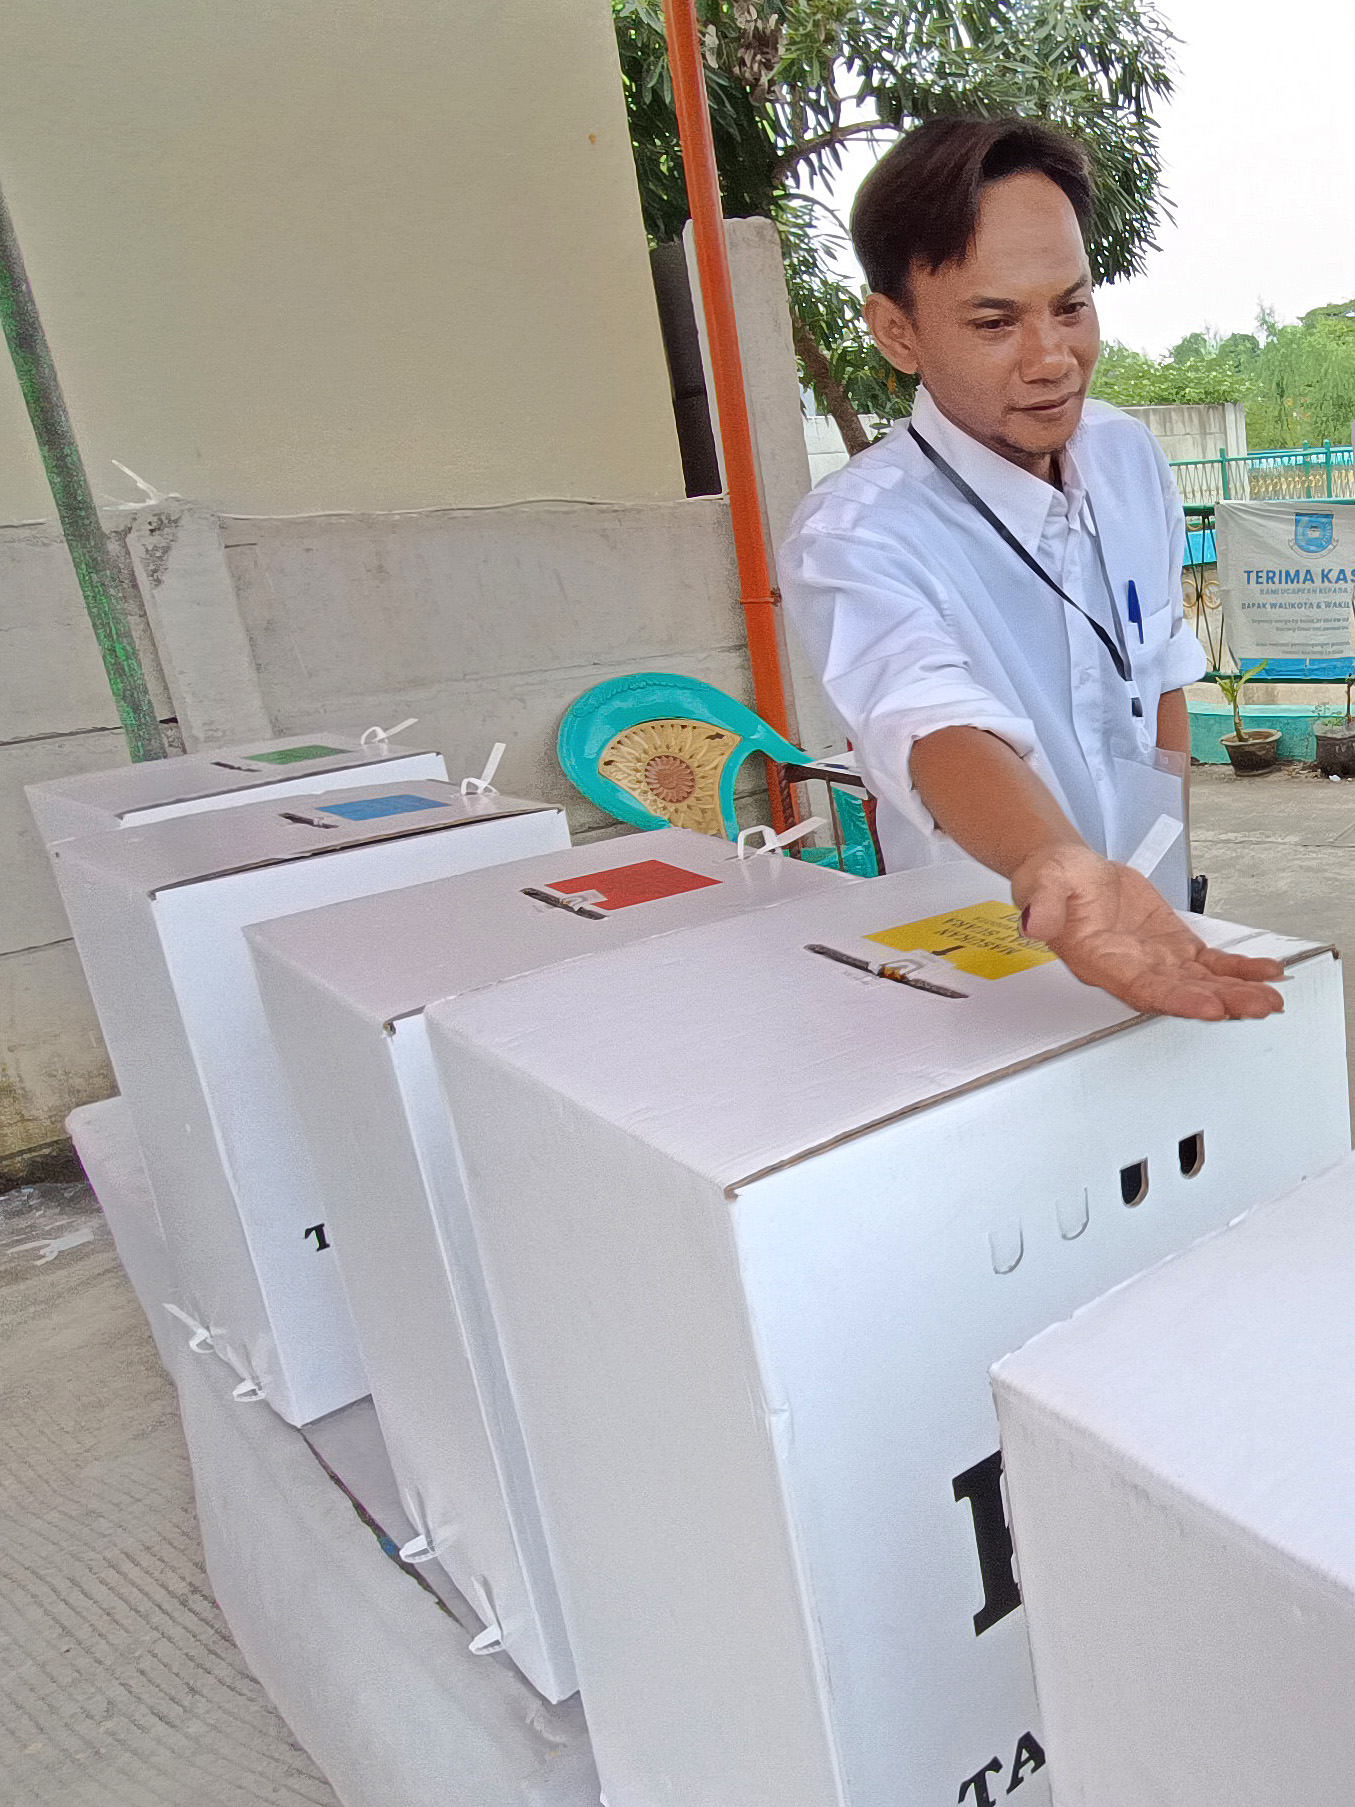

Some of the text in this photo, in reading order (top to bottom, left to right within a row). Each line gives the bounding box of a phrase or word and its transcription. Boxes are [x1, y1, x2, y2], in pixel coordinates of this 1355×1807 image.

[1243, 569, 1315, 585] TERIMA
[1241, 602, 1268, 610] BAPAK
[1270, 601, 1315, 610] WALIKOTA
